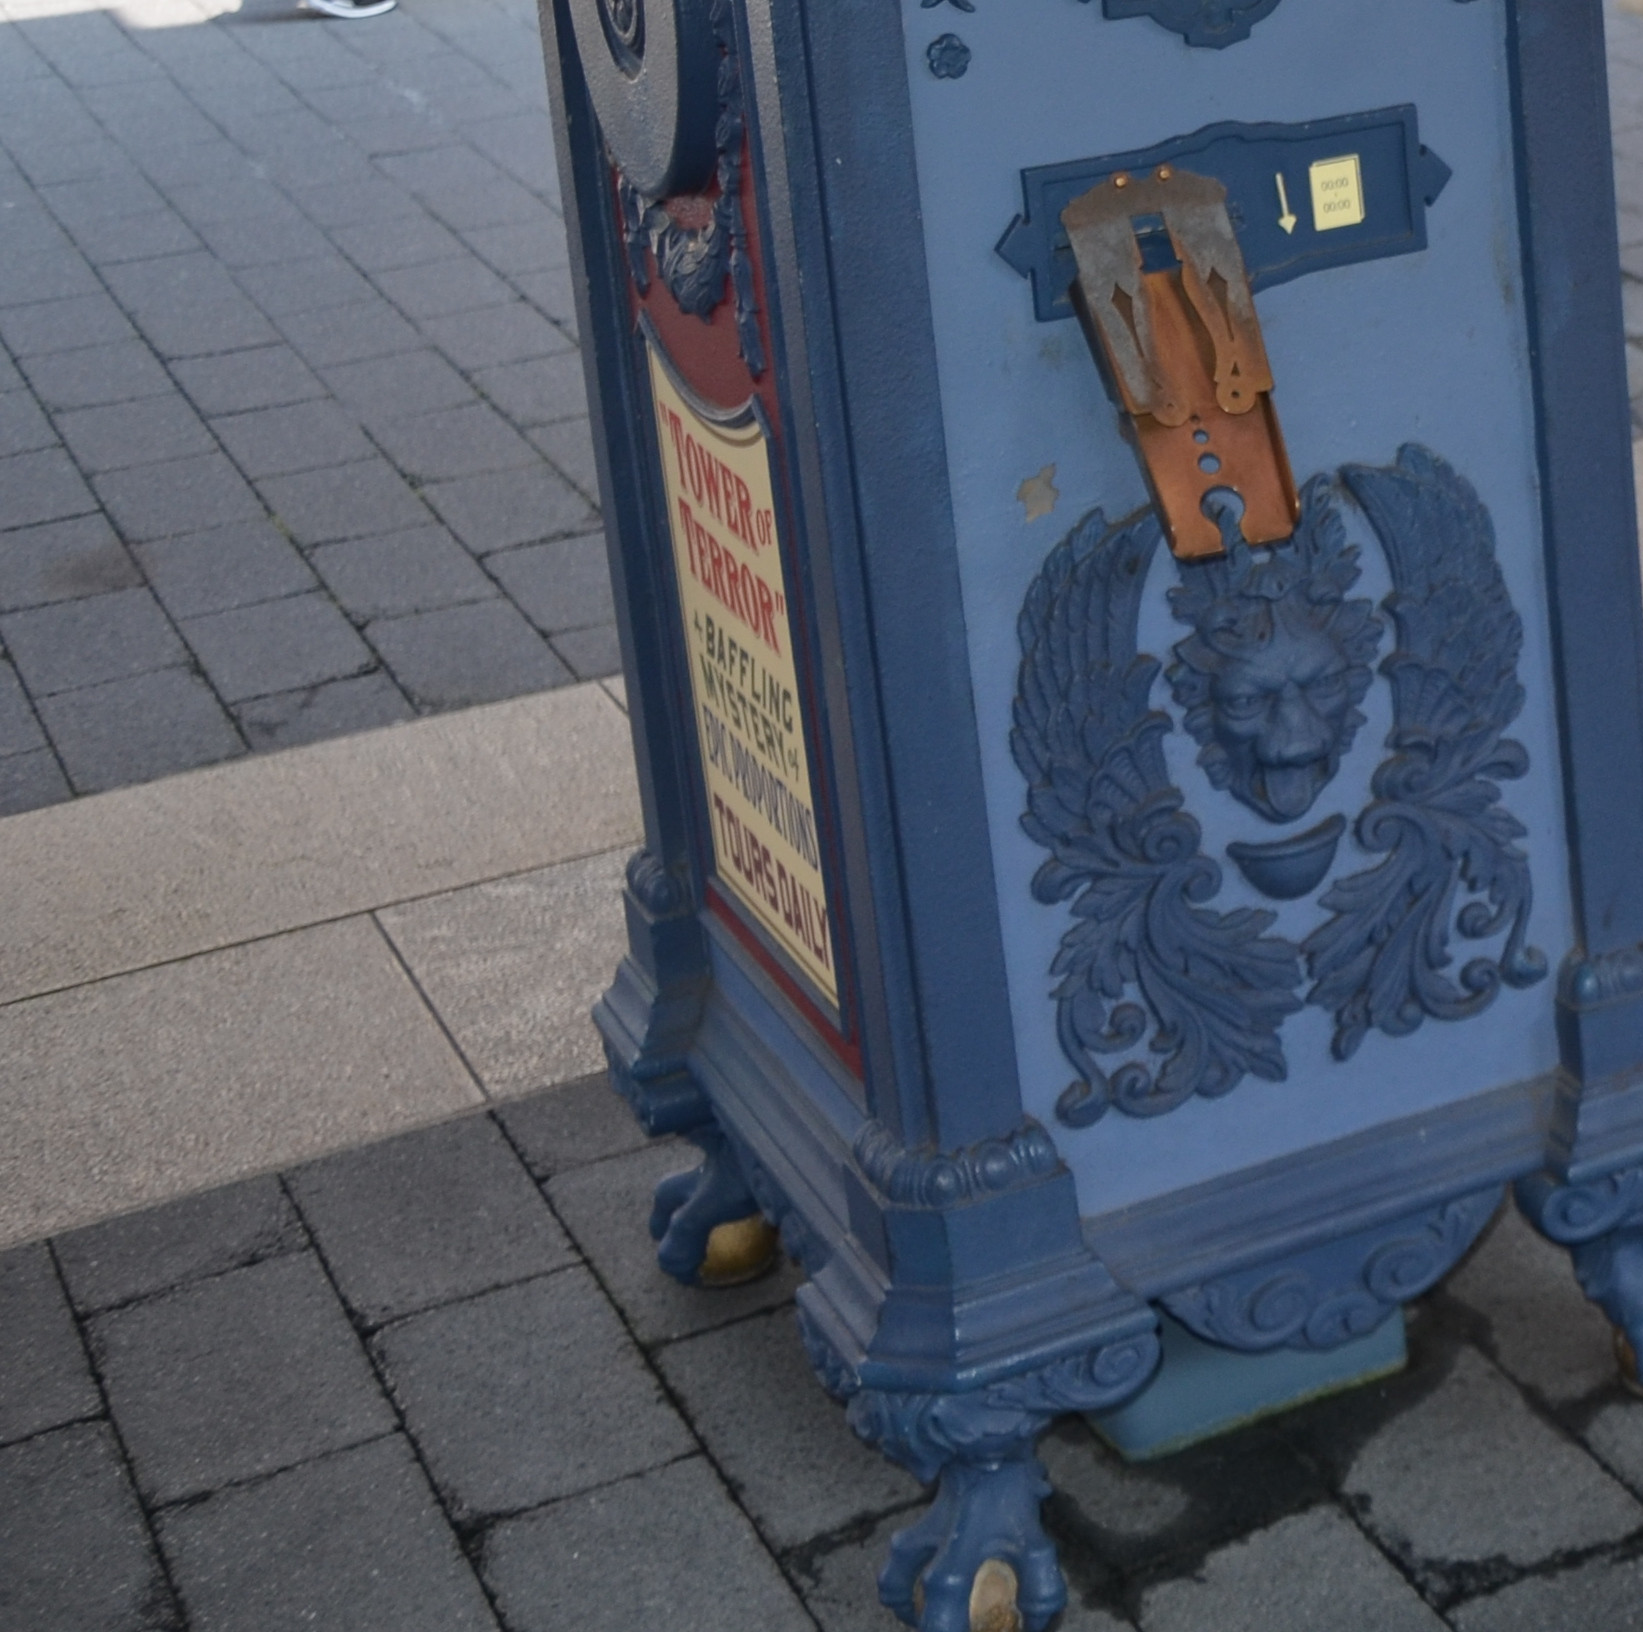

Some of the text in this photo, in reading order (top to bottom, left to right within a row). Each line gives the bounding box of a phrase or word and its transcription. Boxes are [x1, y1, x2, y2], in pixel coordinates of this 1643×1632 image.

[659, 401, 772, 555] "TOWER OF
[678, 496, 785, 657] TERROR"
[700, 653, 788, 777] MYSTERY
[706, 613, 794, 735] BAFFLING
[702, 703, 819, 873] EPIC PROPORTIONS
[713, 792, 830, 971] TOURS DAILY
